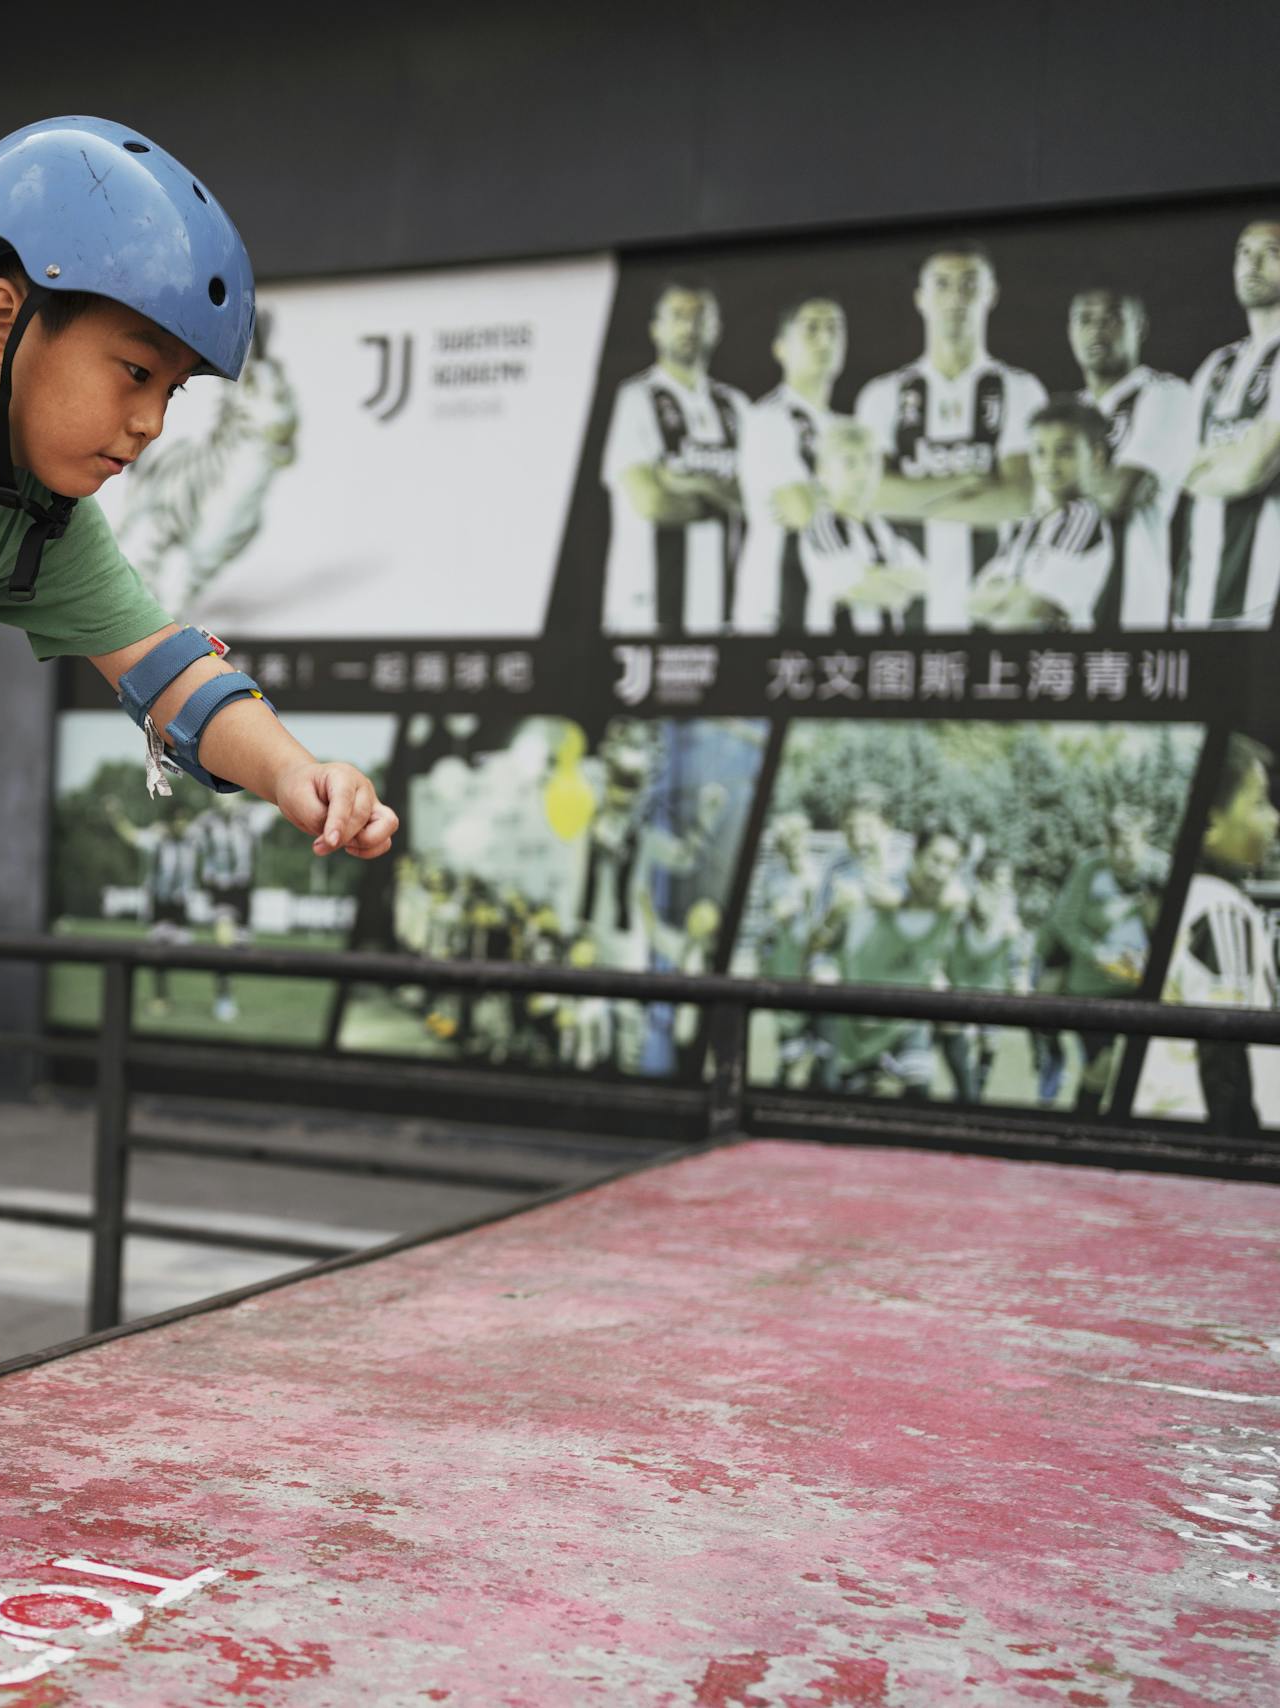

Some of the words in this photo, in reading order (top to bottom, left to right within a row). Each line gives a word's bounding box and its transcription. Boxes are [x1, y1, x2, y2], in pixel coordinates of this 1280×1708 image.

[767, 649, 1190, 700] 尤文图斯上海青训
